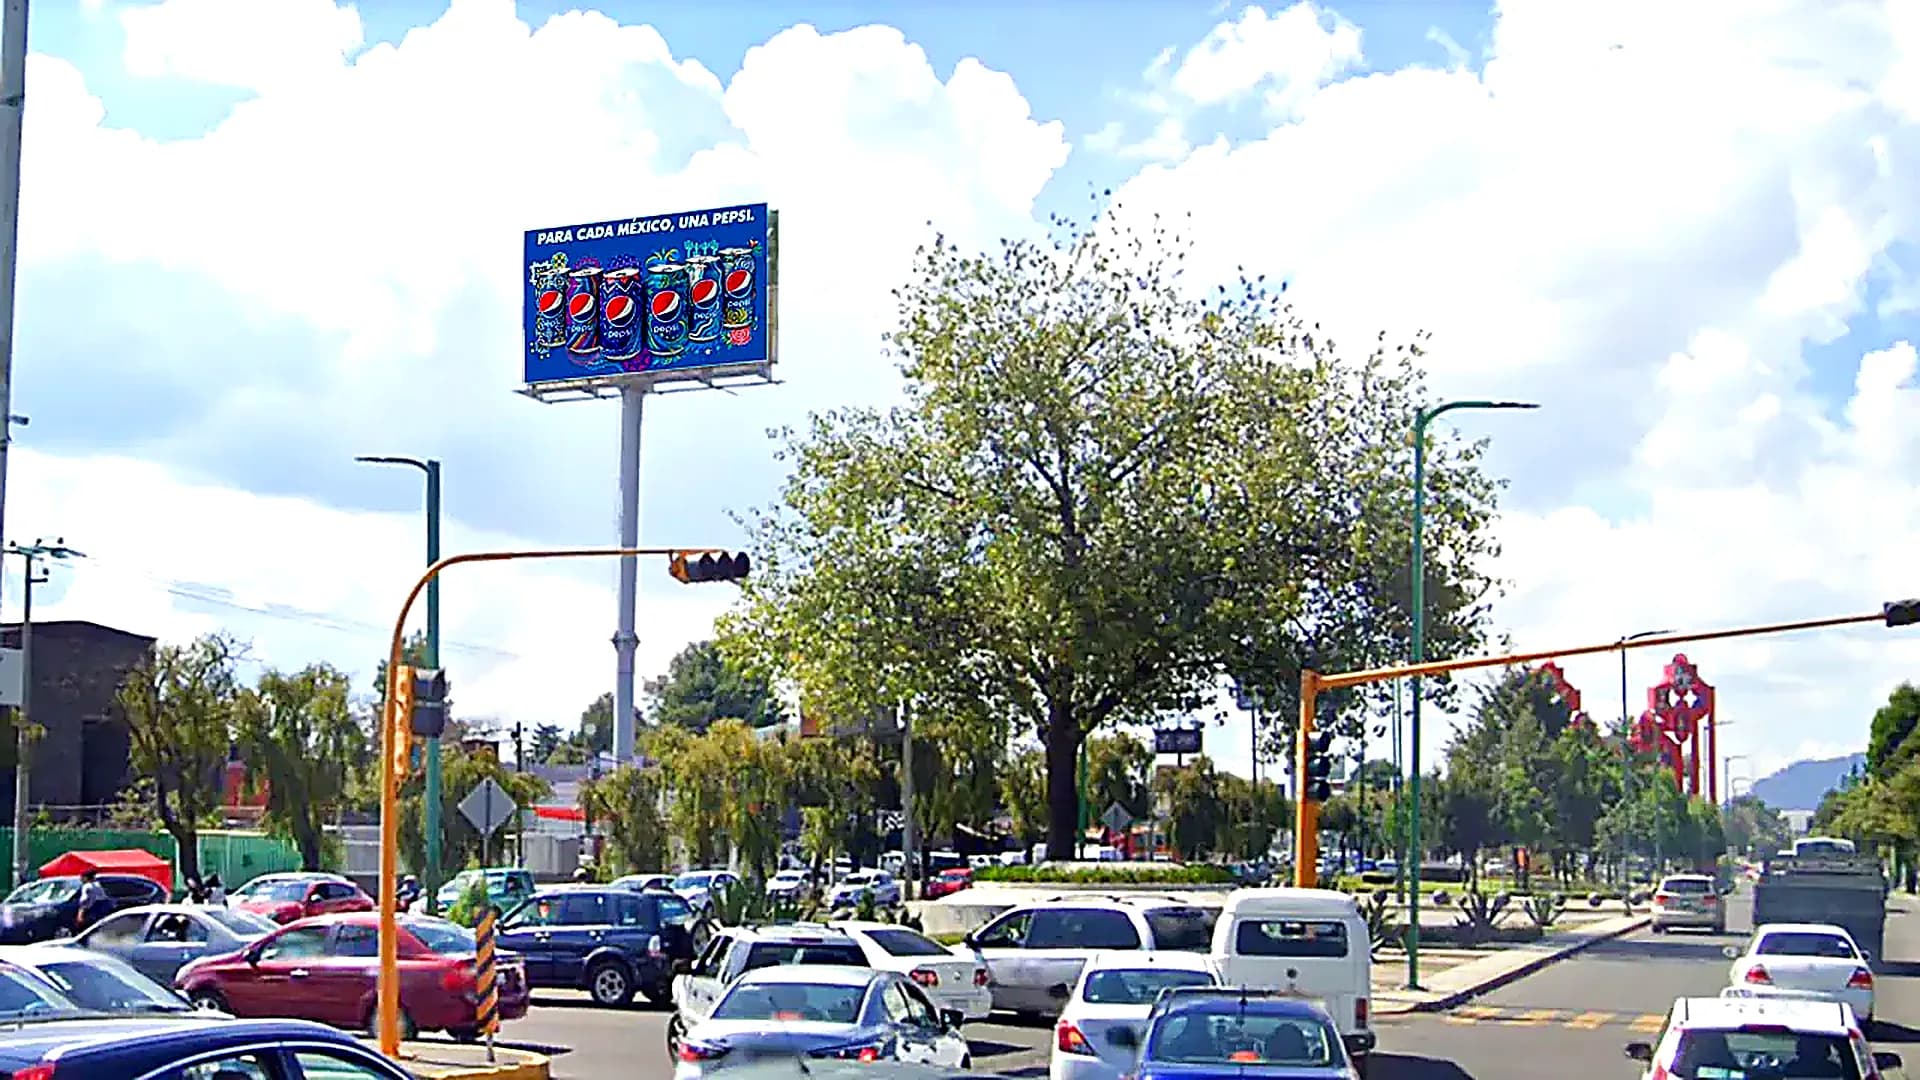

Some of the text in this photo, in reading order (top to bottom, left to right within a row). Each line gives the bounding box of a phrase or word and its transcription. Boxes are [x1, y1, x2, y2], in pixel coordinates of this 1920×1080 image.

[537, 208, 754, 245] PARA CADA MÉXICO, UNA PEPSI.
